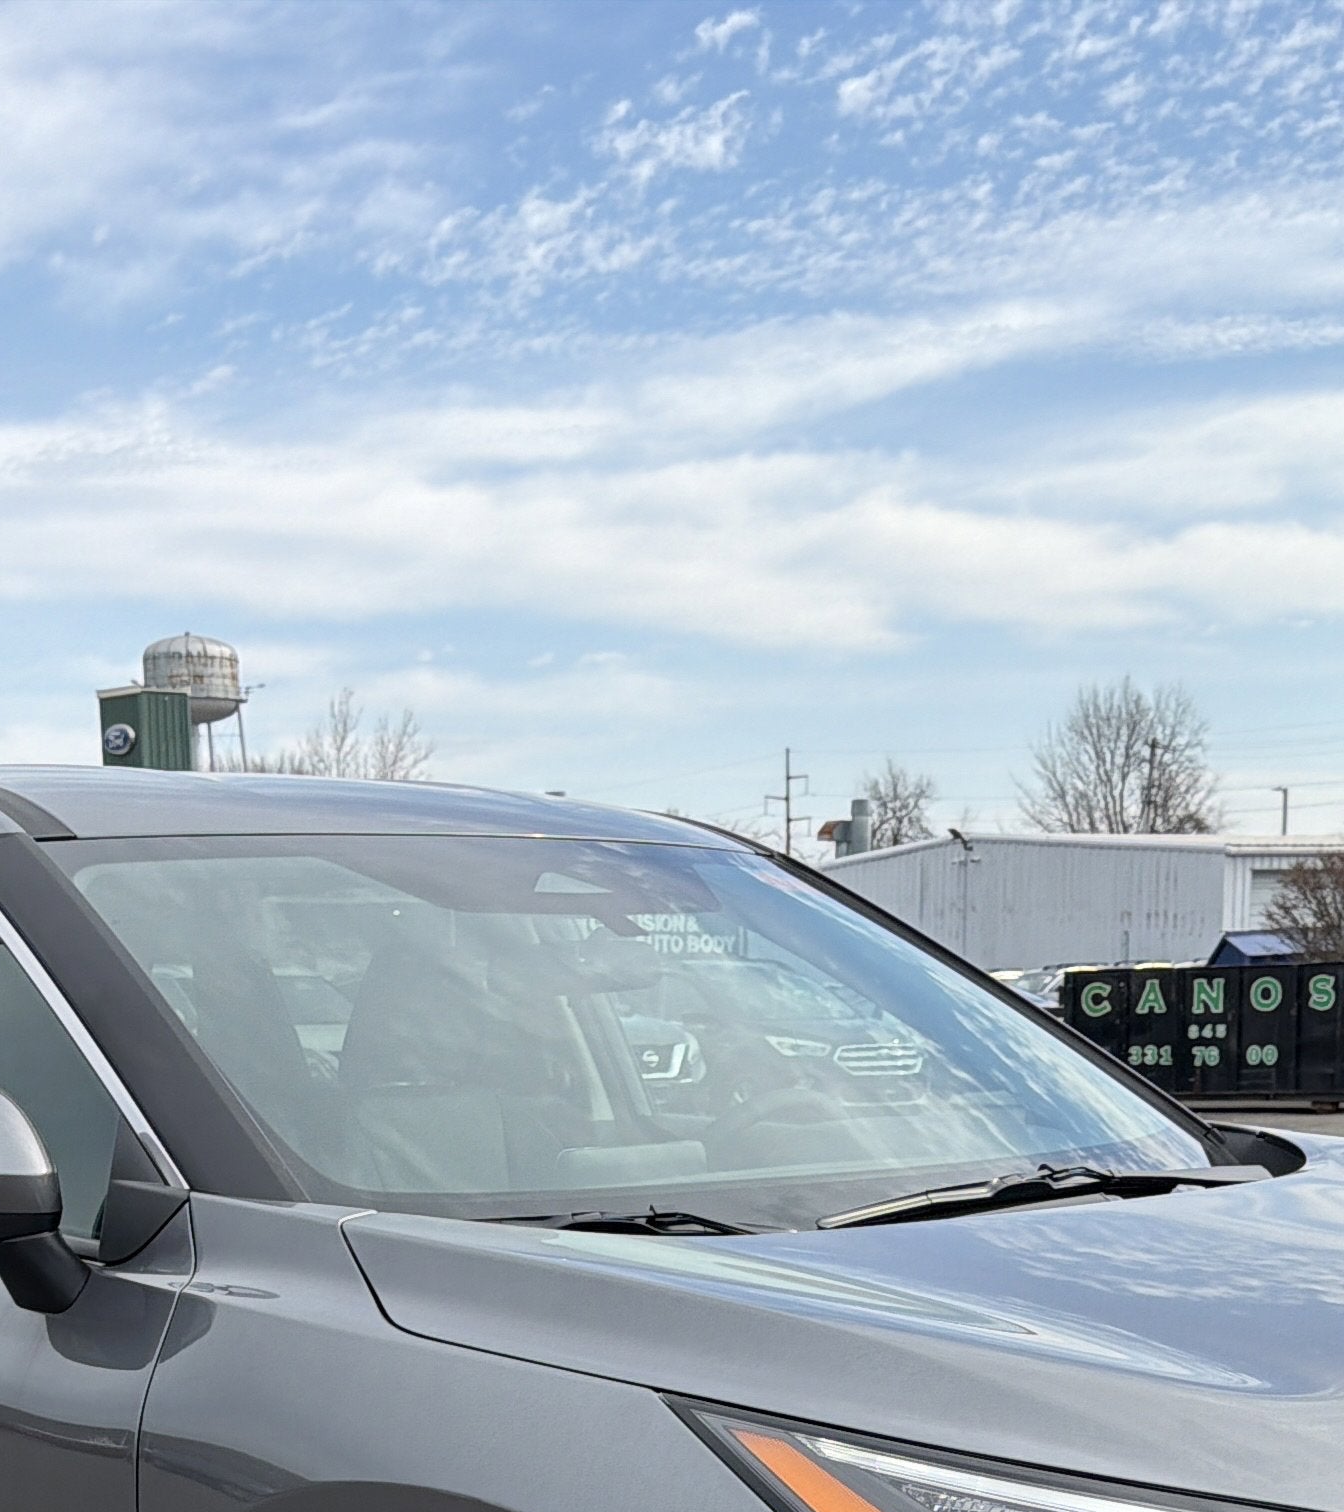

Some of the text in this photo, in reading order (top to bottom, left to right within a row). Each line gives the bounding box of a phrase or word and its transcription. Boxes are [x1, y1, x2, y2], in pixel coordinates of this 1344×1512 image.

[687, 933, 736, 954] BODY
[1080, 973, 1336, 1018] CANOS
[1128, 1045, 1173, 1066] 331
[1246, 1045, 1279, 1066] 00
